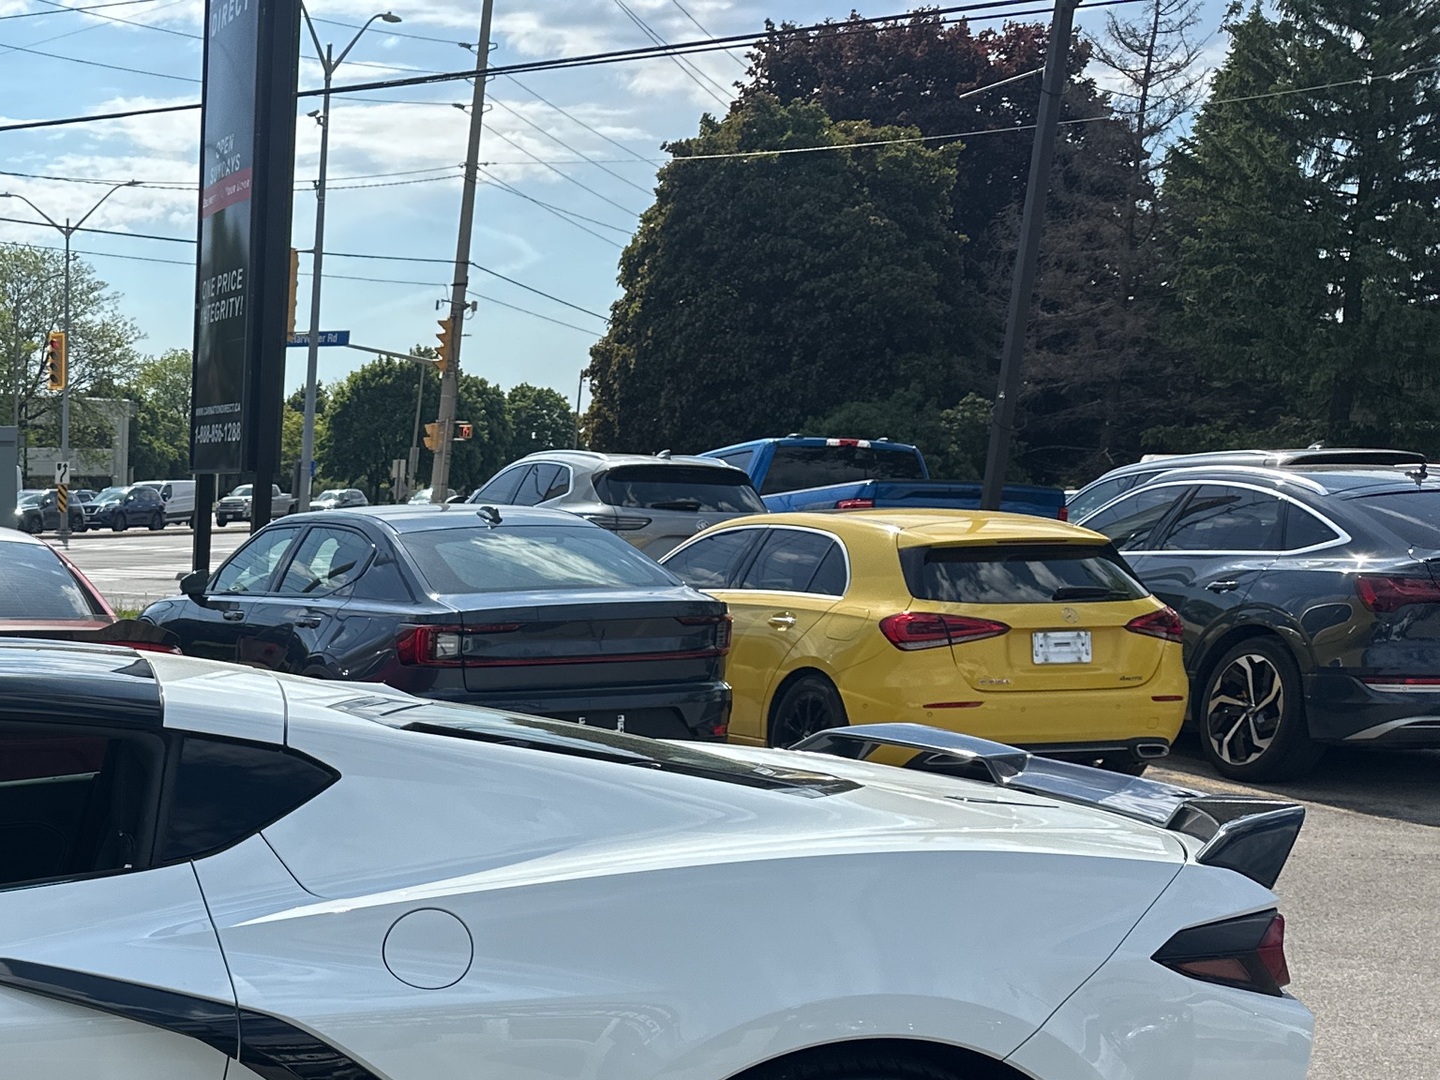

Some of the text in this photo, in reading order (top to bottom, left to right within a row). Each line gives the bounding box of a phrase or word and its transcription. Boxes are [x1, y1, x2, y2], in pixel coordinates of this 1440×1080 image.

[215, 133, 234, 159] OPEN
[216, 268, 244, 295] PRICE
[327, 333, 338, 343] Rd
